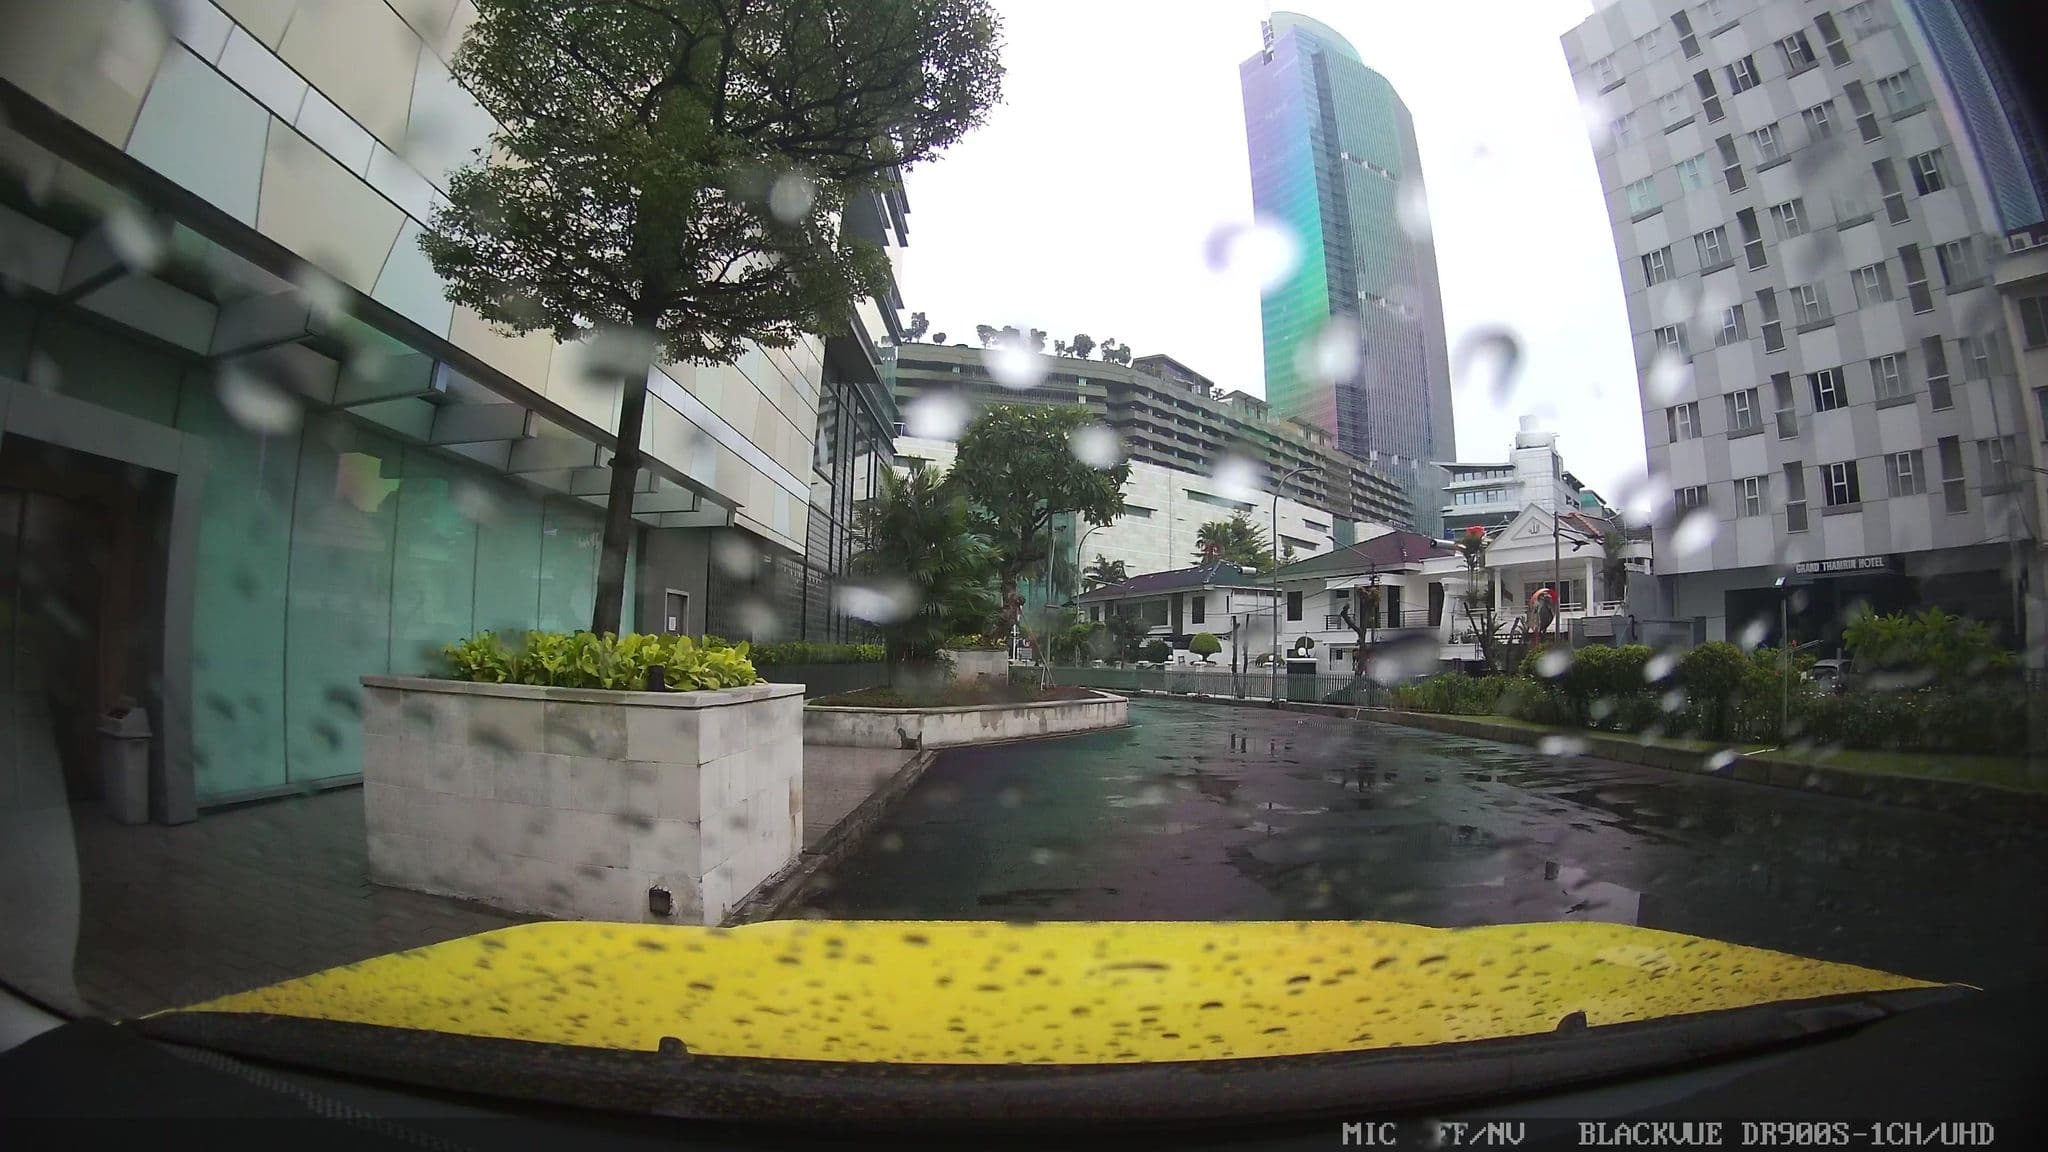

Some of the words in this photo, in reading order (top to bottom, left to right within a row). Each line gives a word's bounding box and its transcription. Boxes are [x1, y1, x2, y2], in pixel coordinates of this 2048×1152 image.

[1795, 562, 1820, 574] GRAND
[1823, 559, 1857, 571] THAMRIN
[1858, 557, 1885, 569] HOTEL
